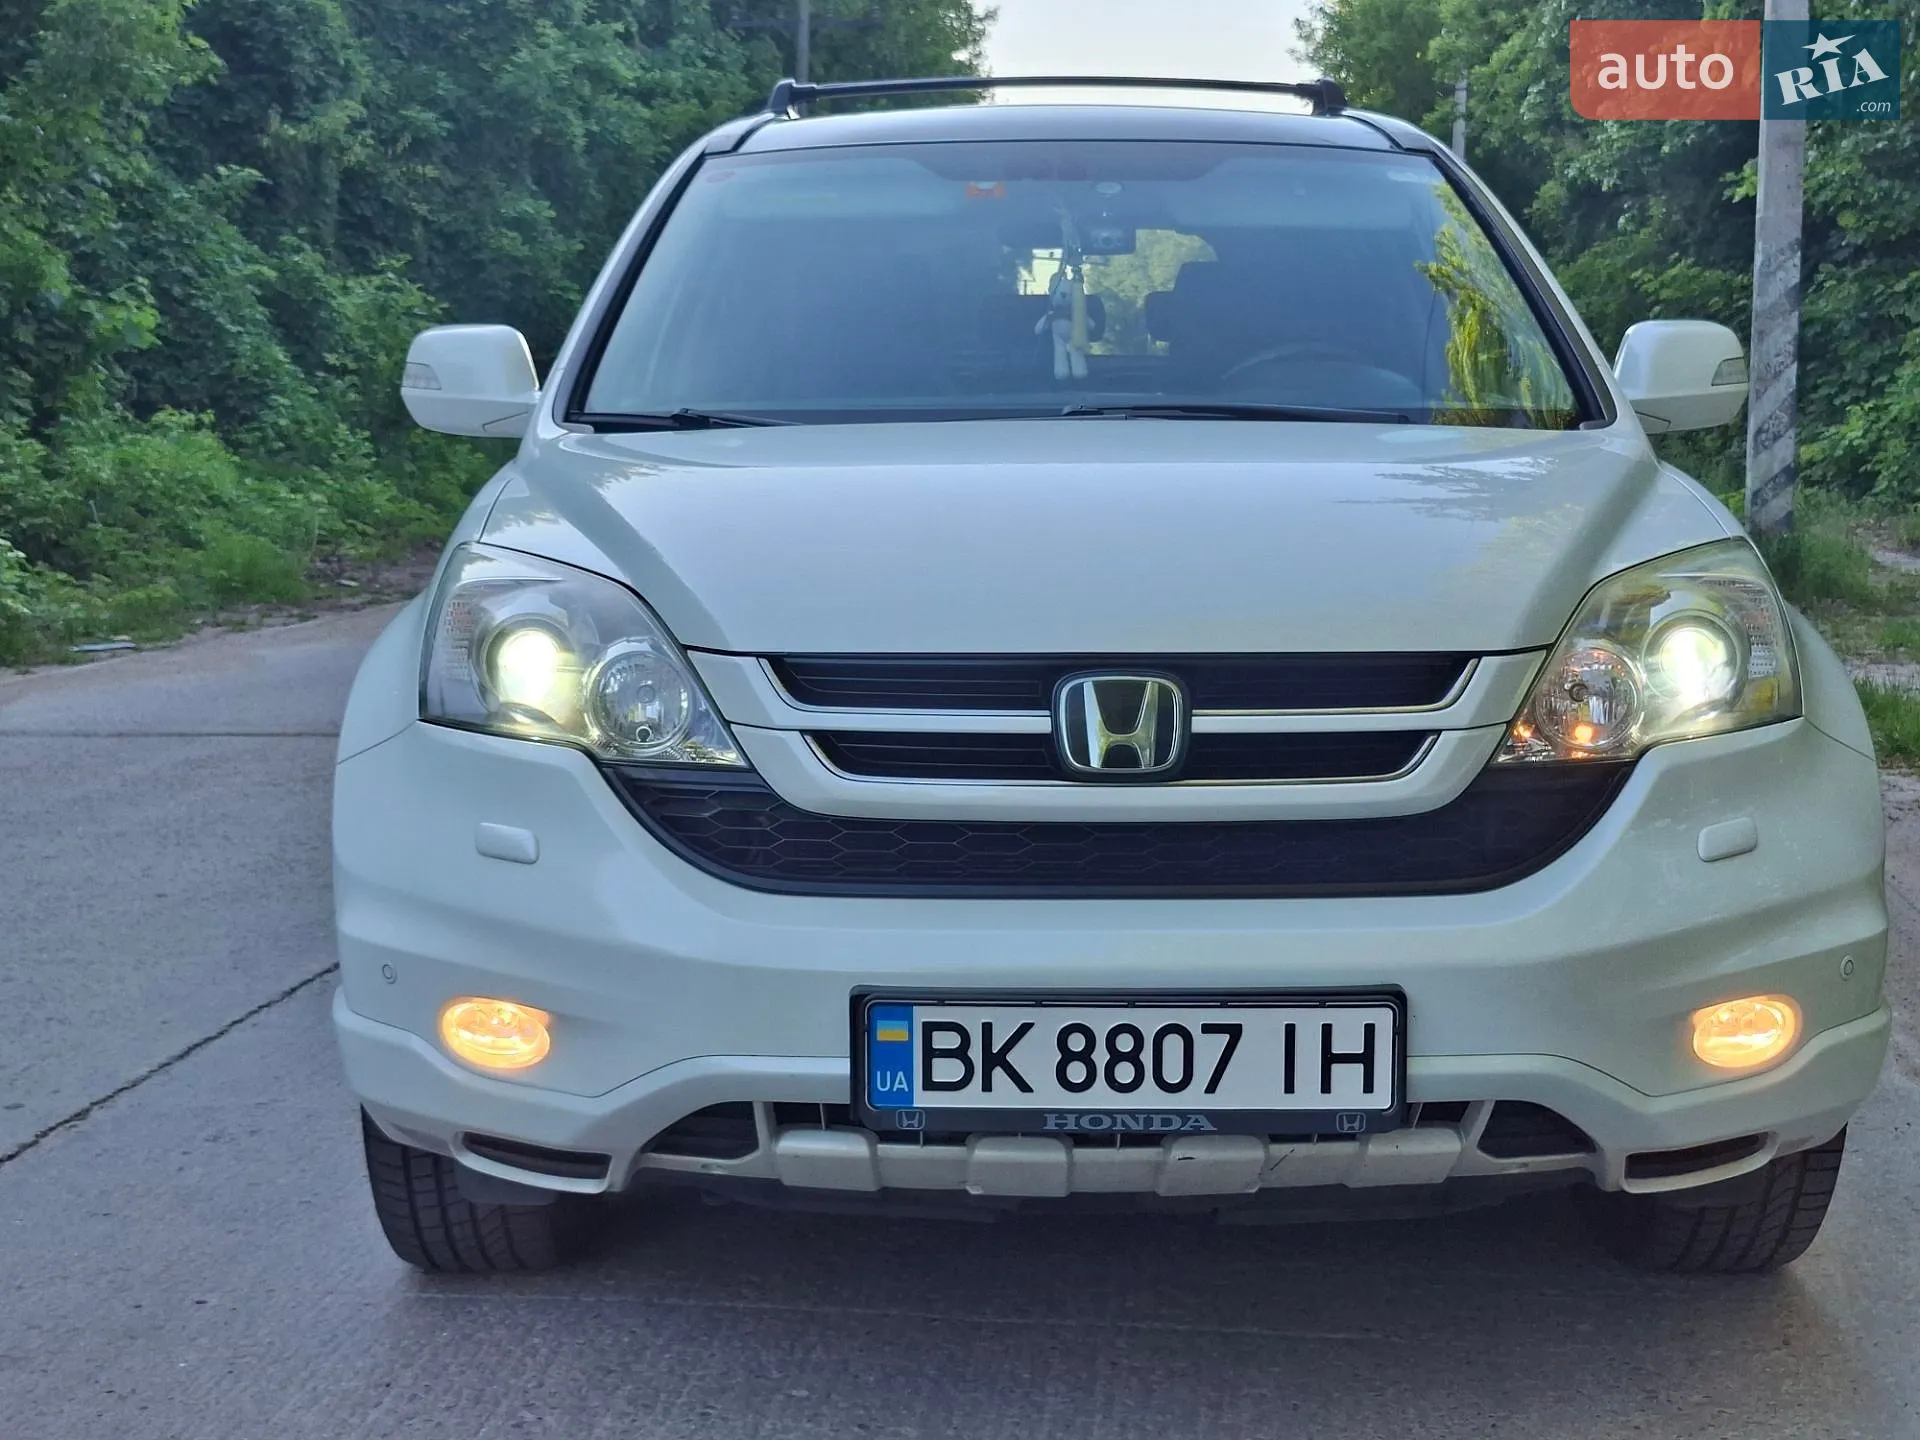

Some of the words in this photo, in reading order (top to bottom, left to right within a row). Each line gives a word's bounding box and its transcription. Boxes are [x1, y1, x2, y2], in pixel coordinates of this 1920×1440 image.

[921, 1021, 1036, 1093] BK
[1055, 1022, 1243, 1094] 8807
[1282, 1022, 1375, 1094] IH
[876, 1071, 909, 1092] UA
[1043, 1113, 1218, 1131] HONDA
